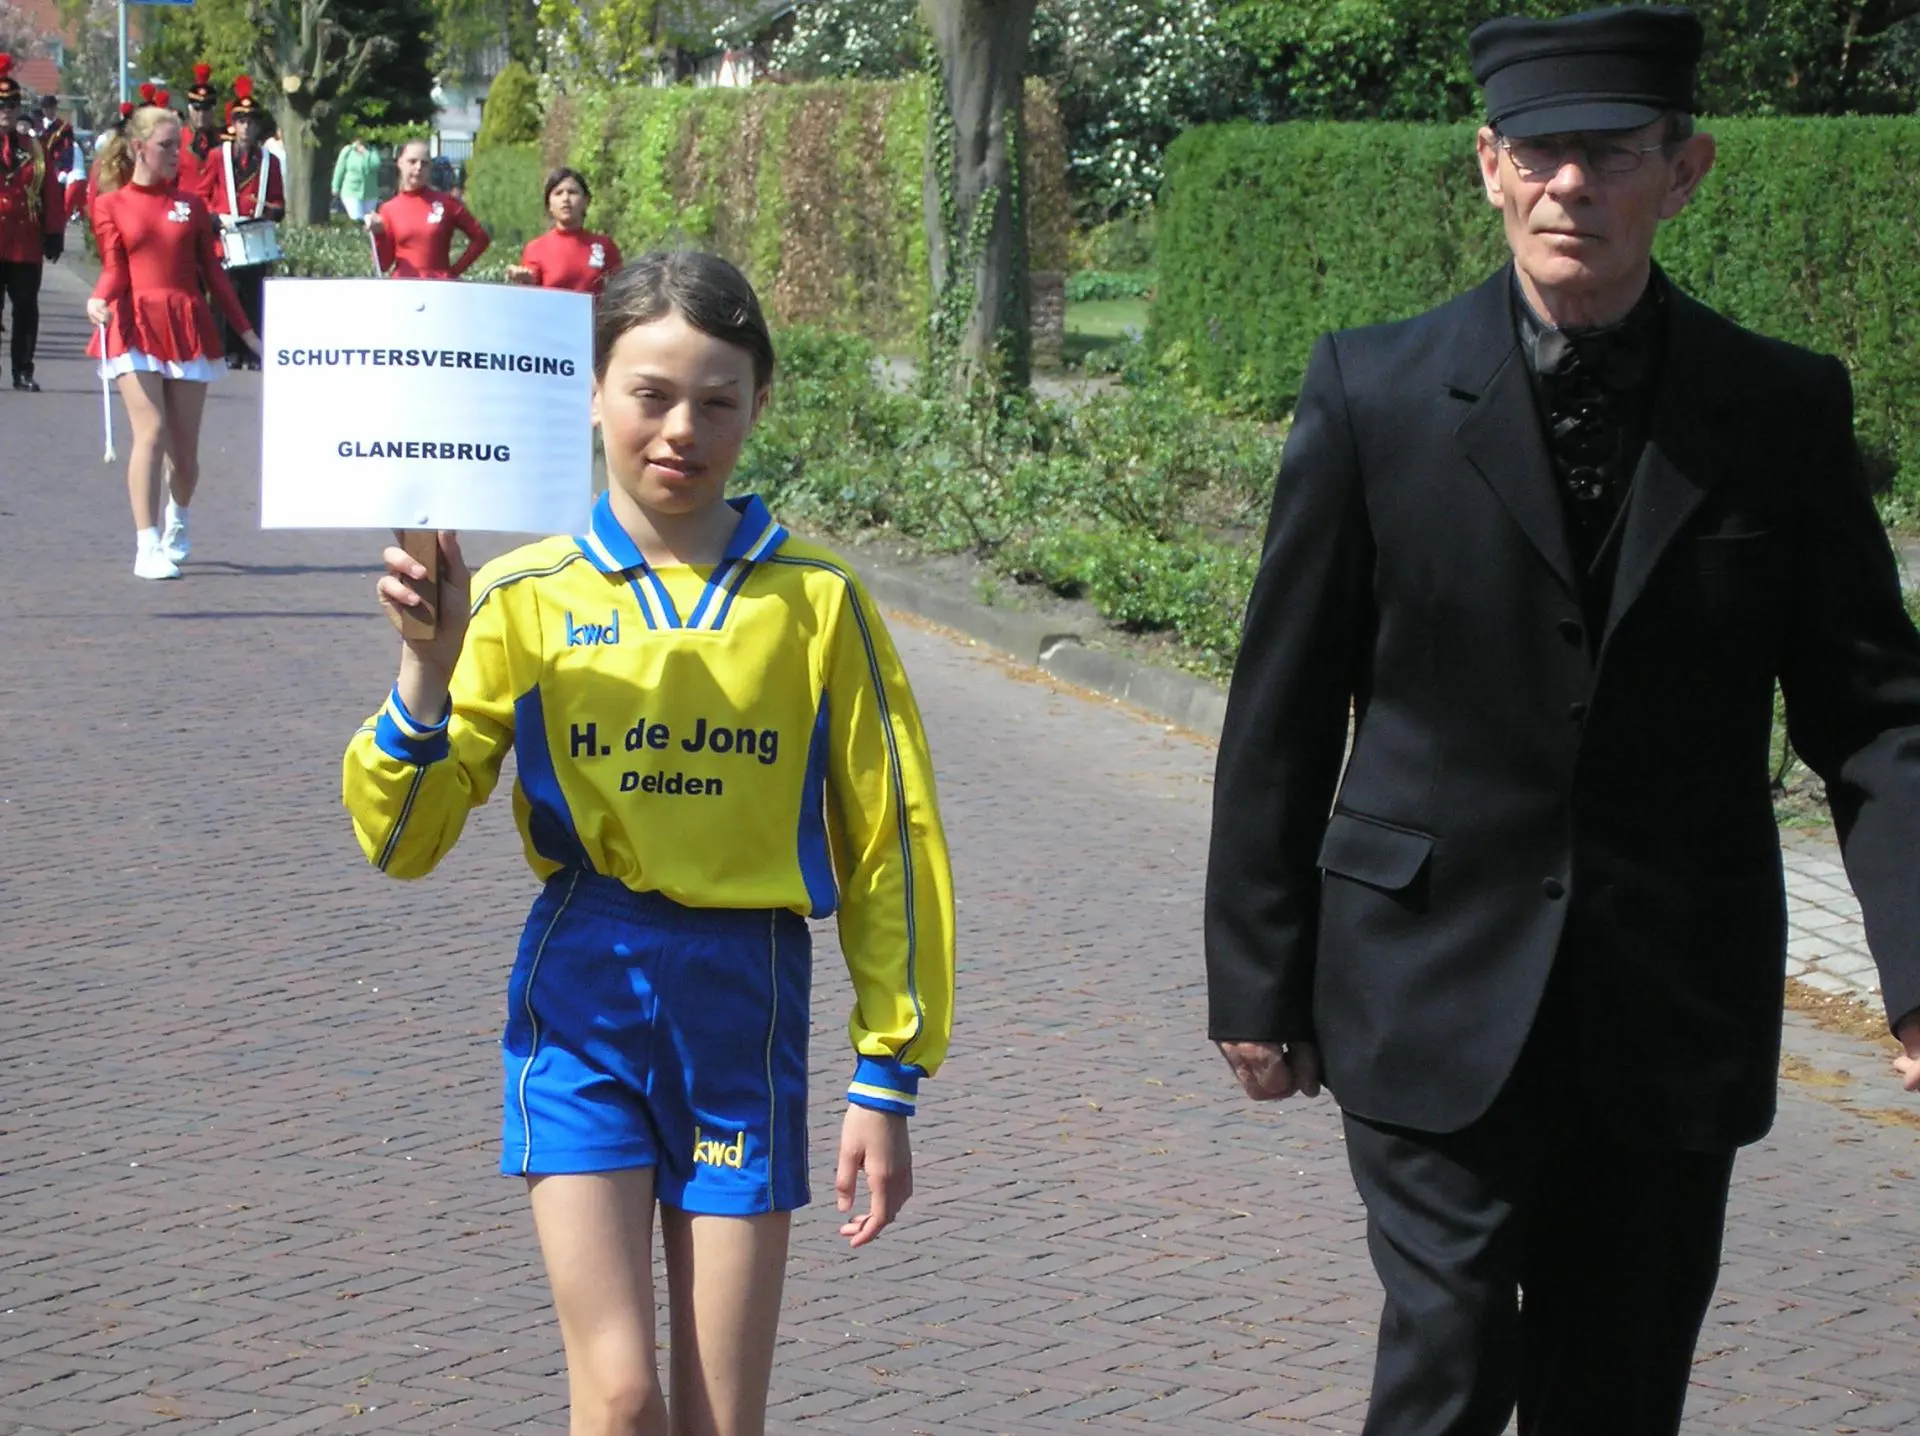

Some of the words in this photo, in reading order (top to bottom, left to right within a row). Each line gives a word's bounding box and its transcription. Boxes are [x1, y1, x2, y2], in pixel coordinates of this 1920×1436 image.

[277, 349, 576, 377] SCHUTTERSVERENIGING
[337, 441, 511, 462] GLANERBRUG
[565, 608, 620, 646] kwd
[570, 722, 611, 758] H.
[625, 718, 670, 752] de
[681, 718, 779, 765] Jong
[619, 771, 723, 796] Delden
[693, 1126, 744, 1169] kwd
